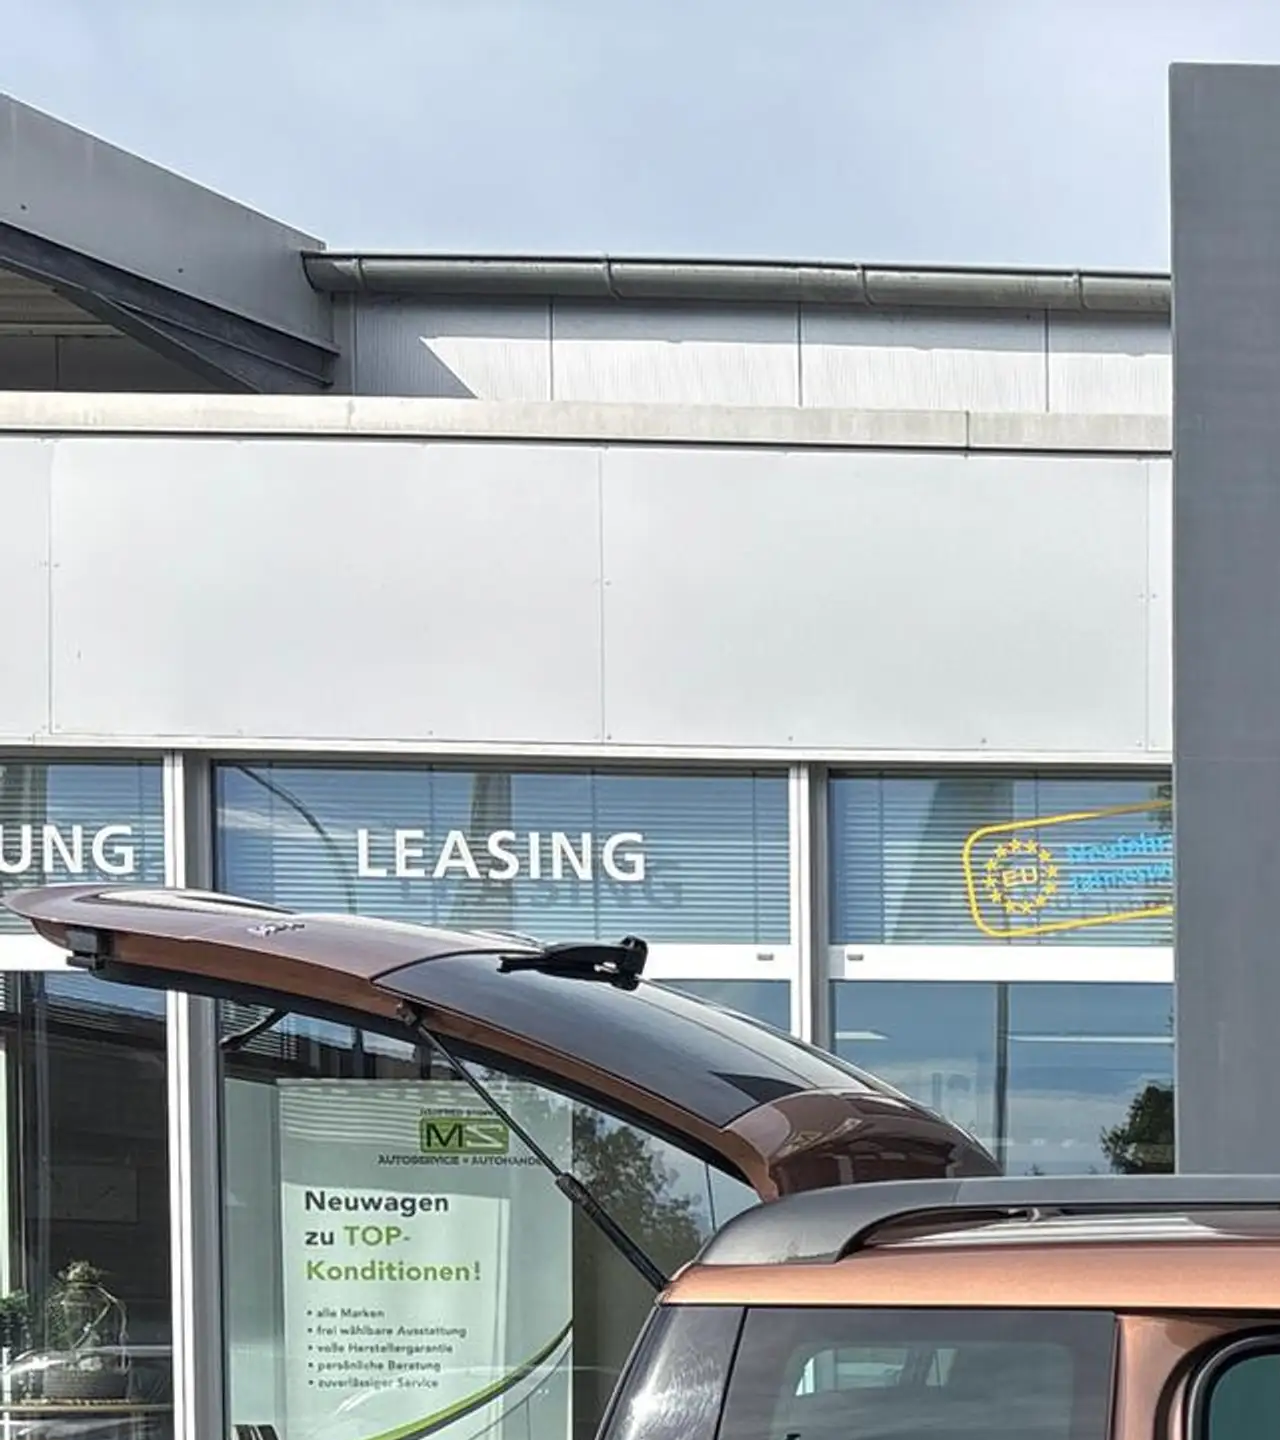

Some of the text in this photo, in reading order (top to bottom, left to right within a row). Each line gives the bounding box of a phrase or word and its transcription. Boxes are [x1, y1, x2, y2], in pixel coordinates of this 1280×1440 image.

[357, 828, 646, 881] LEASING
[305, 1190, 449, 1217] Neuwagen
[305, 1225, 411, 1246] zu TOP-
[307, 1260, 481, 1281] Konditionen!
[340, 1308, 385, 1318] Marken
[317, 1325, 467, 1338] frei wählbare Ausstattung
[388, 1360, 441, 1372] Beratung
[398, 1377, 439, 1388] Service
